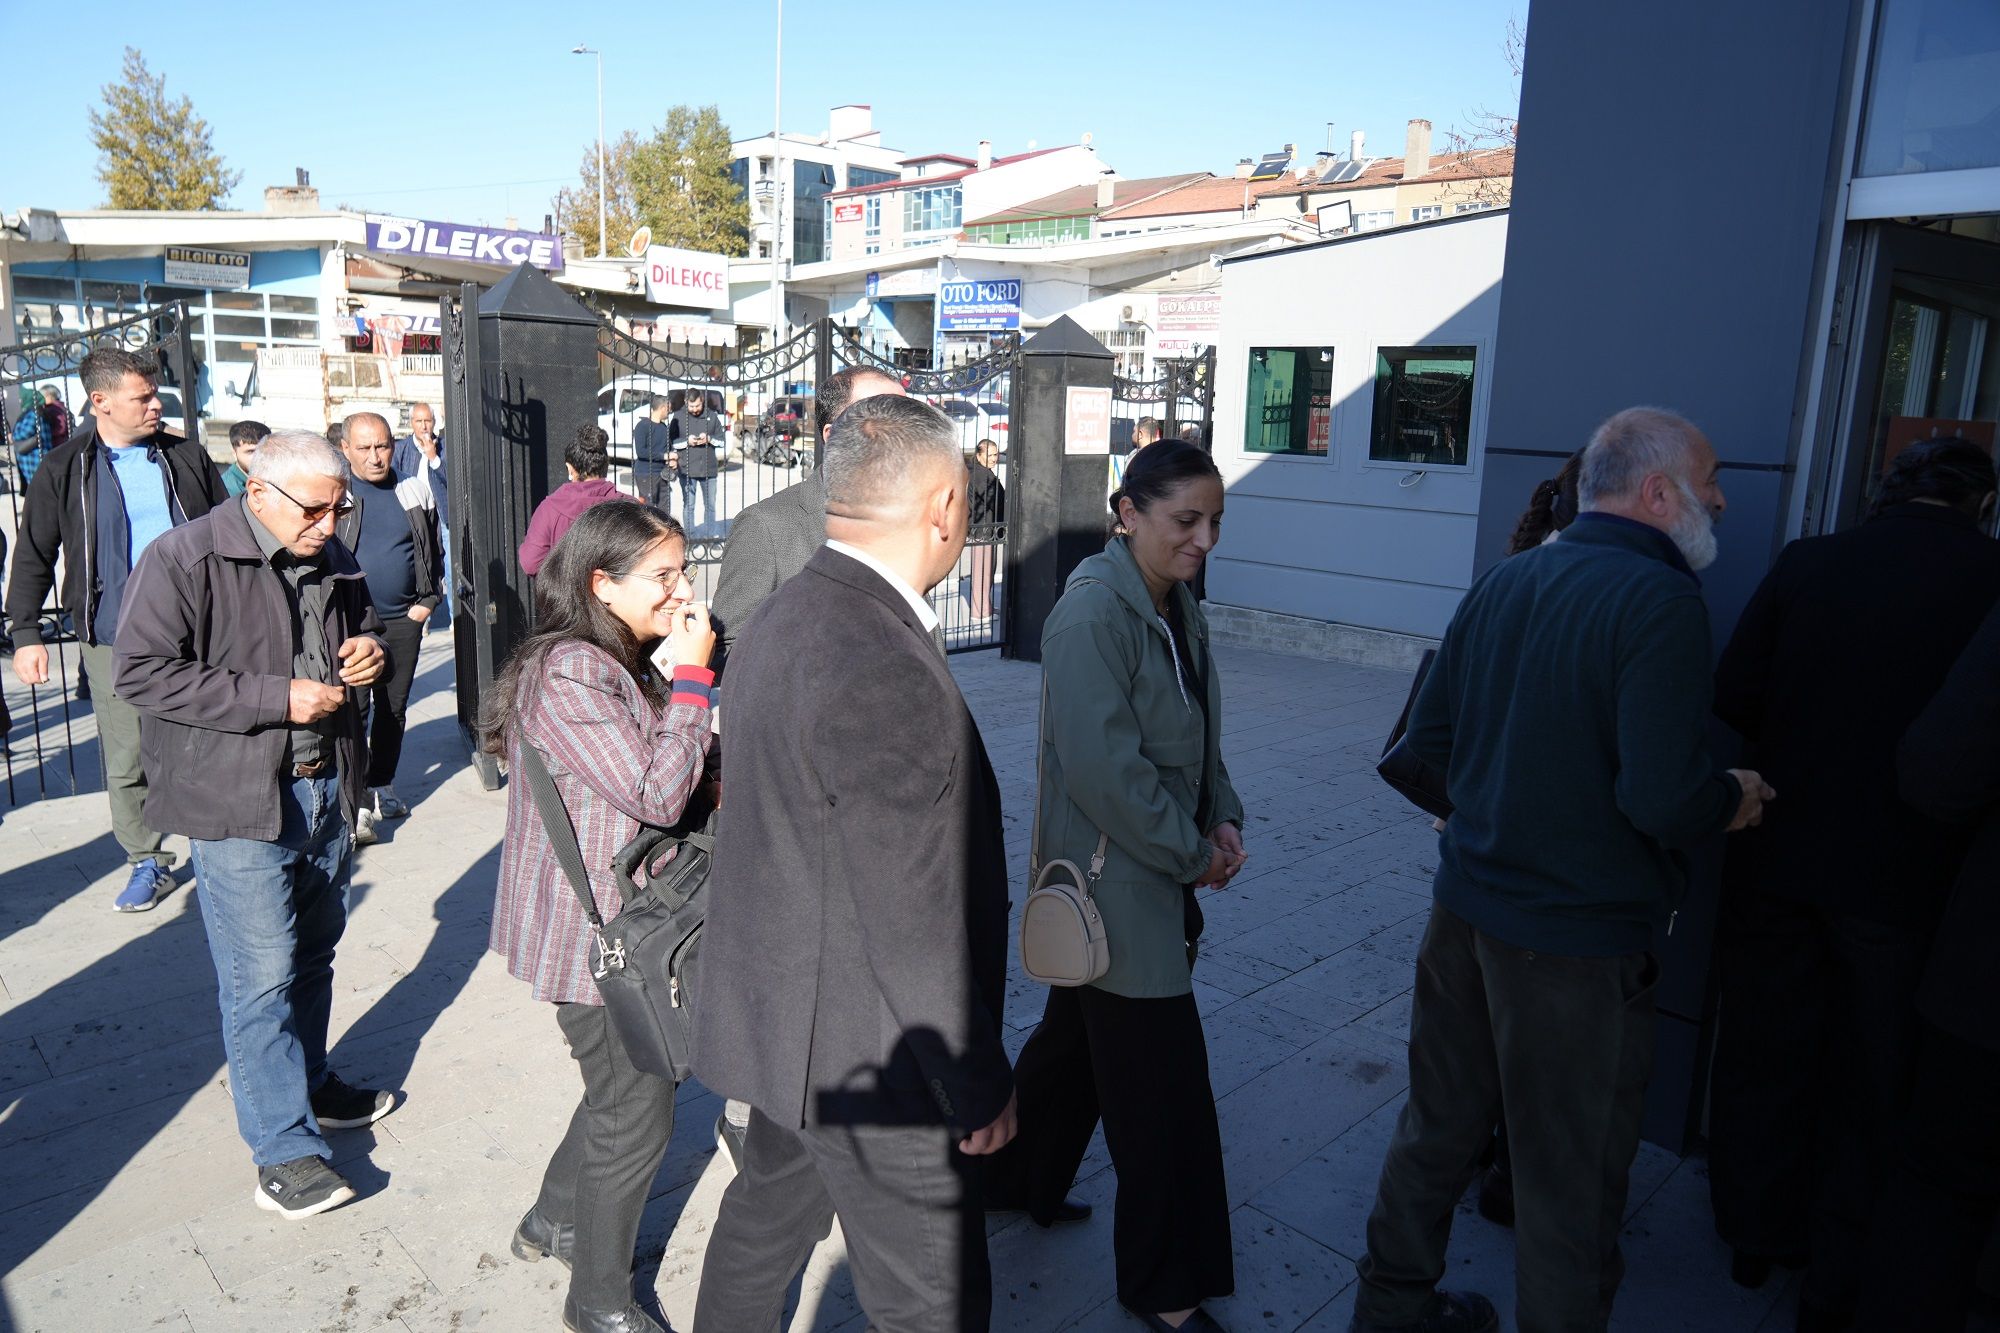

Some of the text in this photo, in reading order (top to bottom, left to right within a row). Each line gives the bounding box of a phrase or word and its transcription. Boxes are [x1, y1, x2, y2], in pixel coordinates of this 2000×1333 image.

[377, 221, 553, 265] DİLEKÇE
[170, 249, 245, 266] BİLGİN OTO
[652, 264, 723, 292] DİLEKÇE
[942, 284, 974, 303] OTO
[977, 282, 1019, 302] FORD
[1159, 339, 1189, 350] MUTLU
